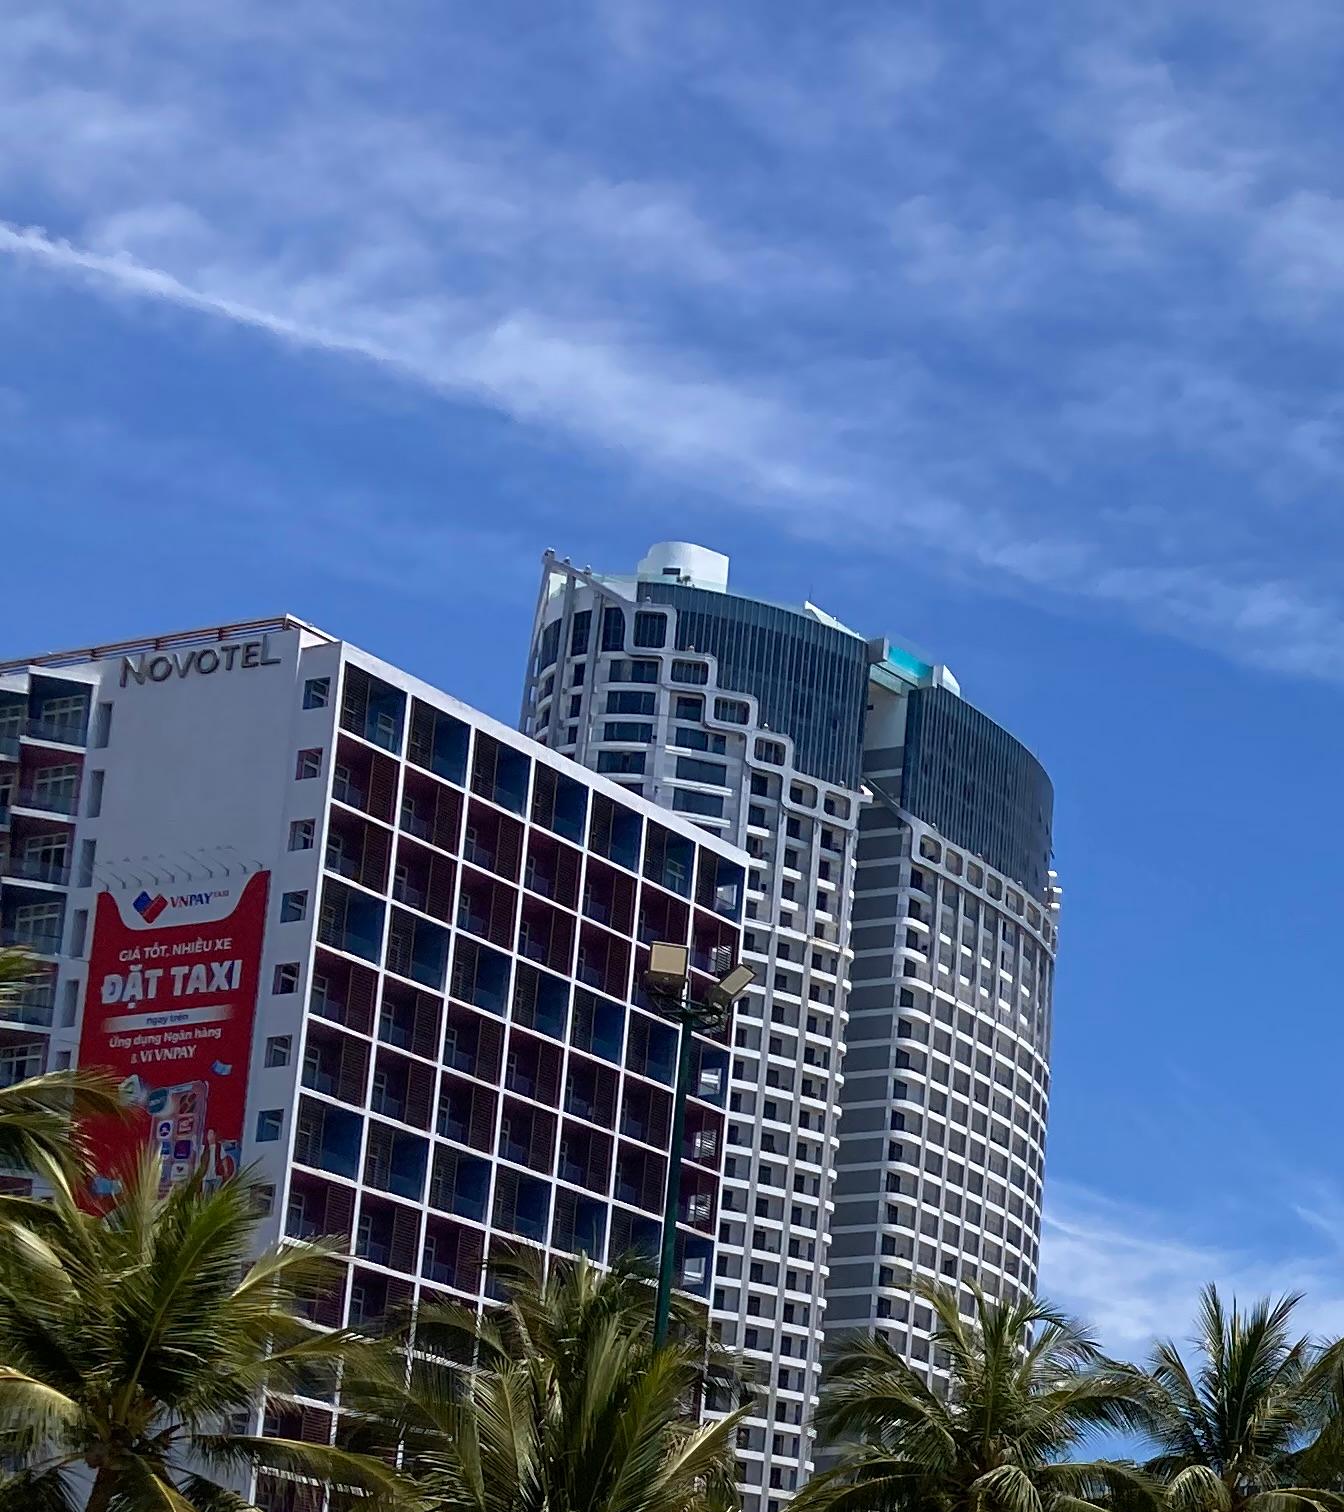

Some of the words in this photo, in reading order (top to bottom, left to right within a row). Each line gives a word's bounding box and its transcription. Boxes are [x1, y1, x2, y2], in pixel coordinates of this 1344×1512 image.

[119, 634, 282, 688] NOVOTEL
[170, 892, 213, 908] VNPAY
[119, 946, 141, 962] GIÁ
[172, 936, 213, 956] NHIỀU
[215, 938, 233, 951] XE
[101, 963, 164, 1009] ĐẶT
[170, 959, 243, 997] TAXI
[146, 1015, 168, 1026] ngay
[133, 1034, 162, 1047] dụng
[194, 1026, 222, 1040] hàng
[130, 1053, 138, 1065] &
[154, 1044, 197, 1061] VNPAY
